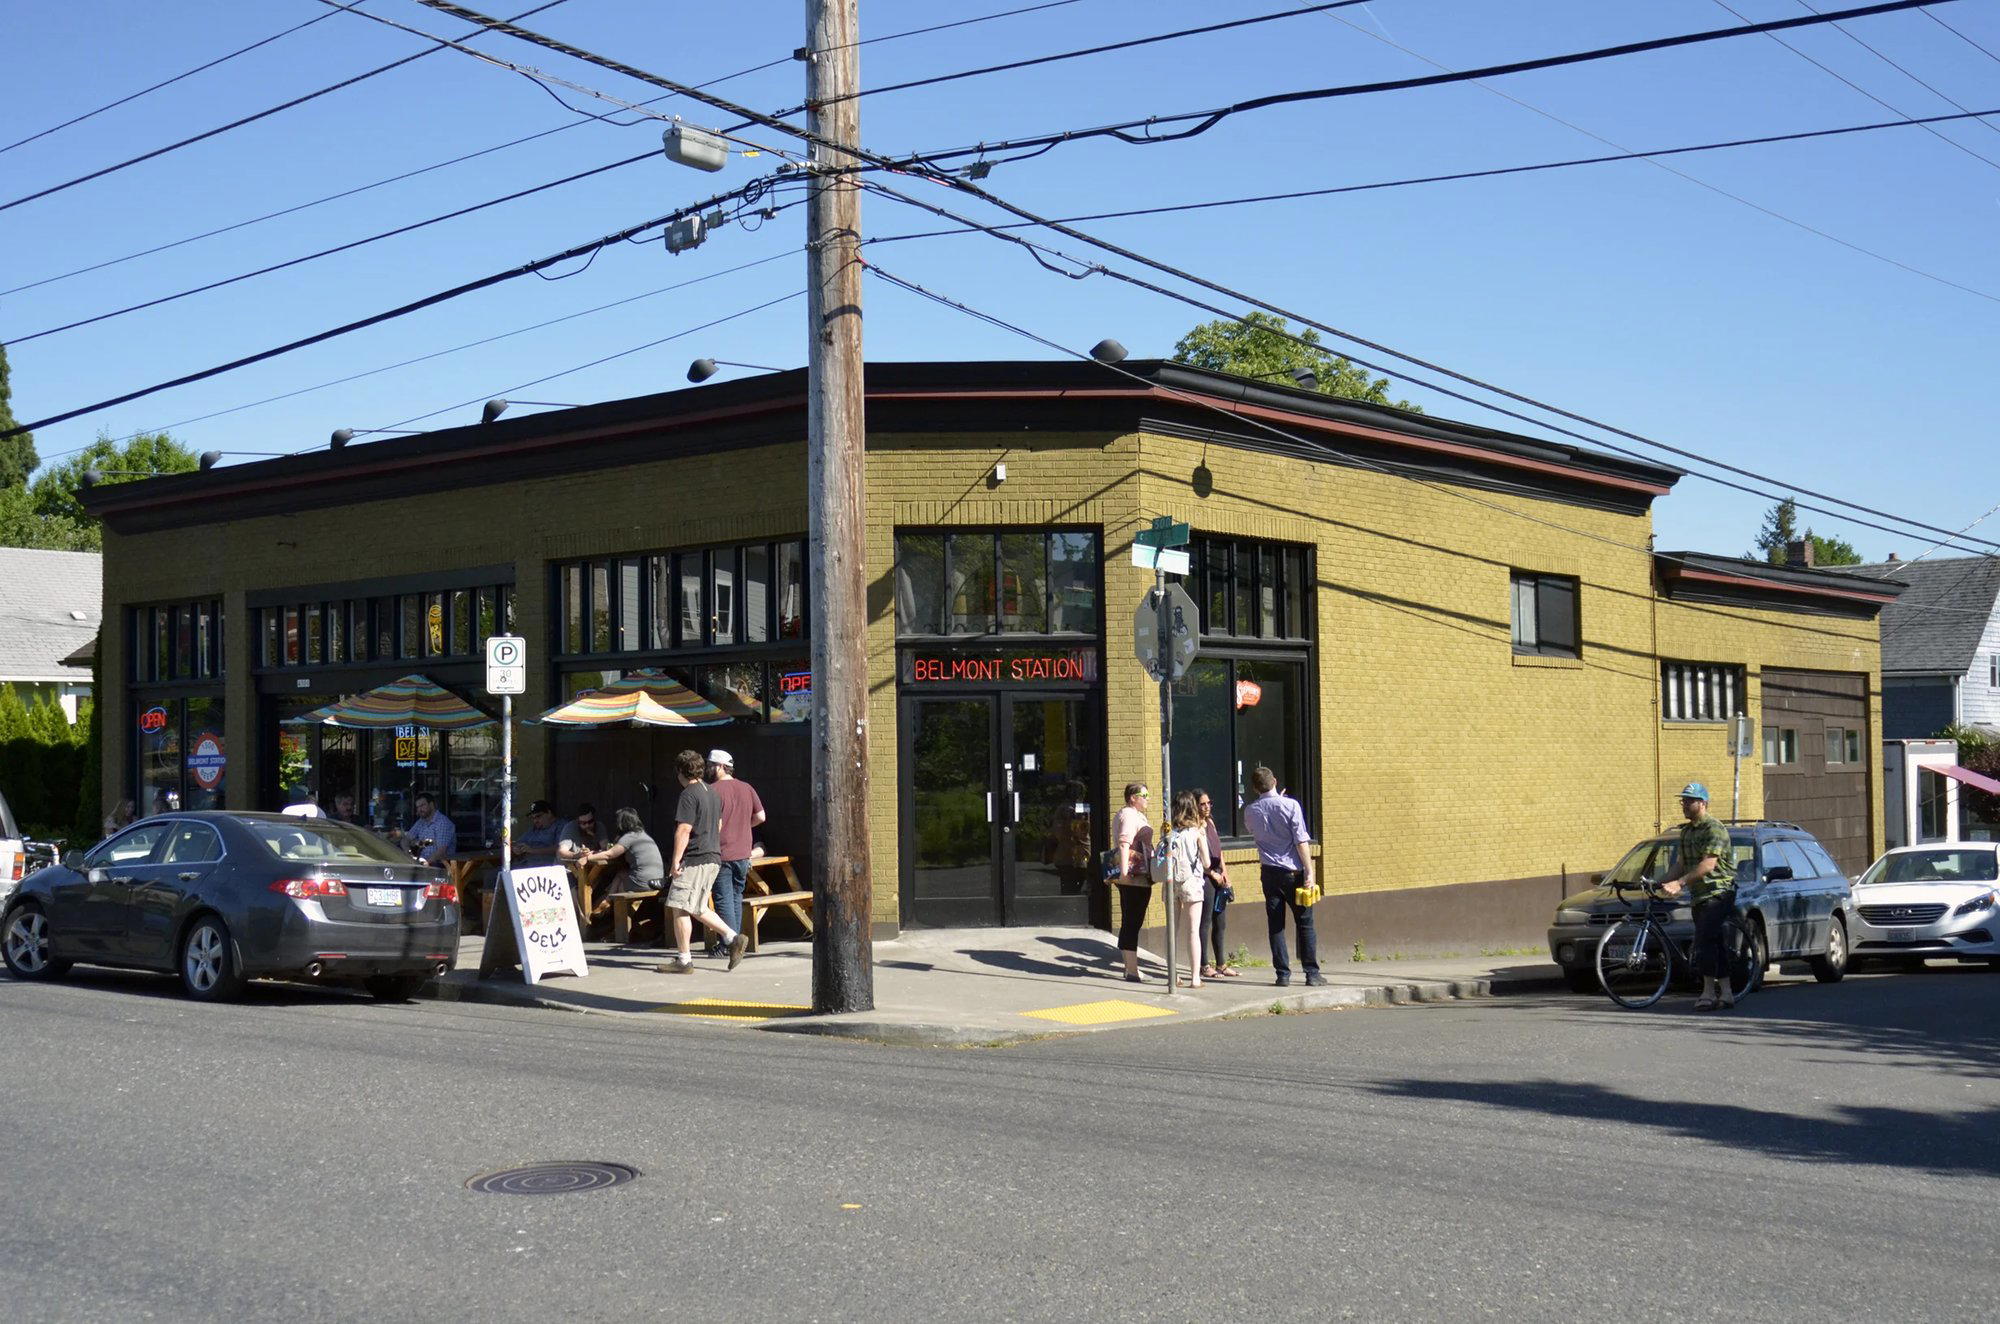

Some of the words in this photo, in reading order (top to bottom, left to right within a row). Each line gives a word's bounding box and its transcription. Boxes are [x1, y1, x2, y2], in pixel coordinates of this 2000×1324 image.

[501, 646, 513, 661] P
[914, 658, 1003, 681] BELMONT
[1011, 657, 1083, 681] STATION
[780, 675, 812, 692] OPE
[140, 712, 166, 728] OPEN
[528, 927, 568, 948] DELI
